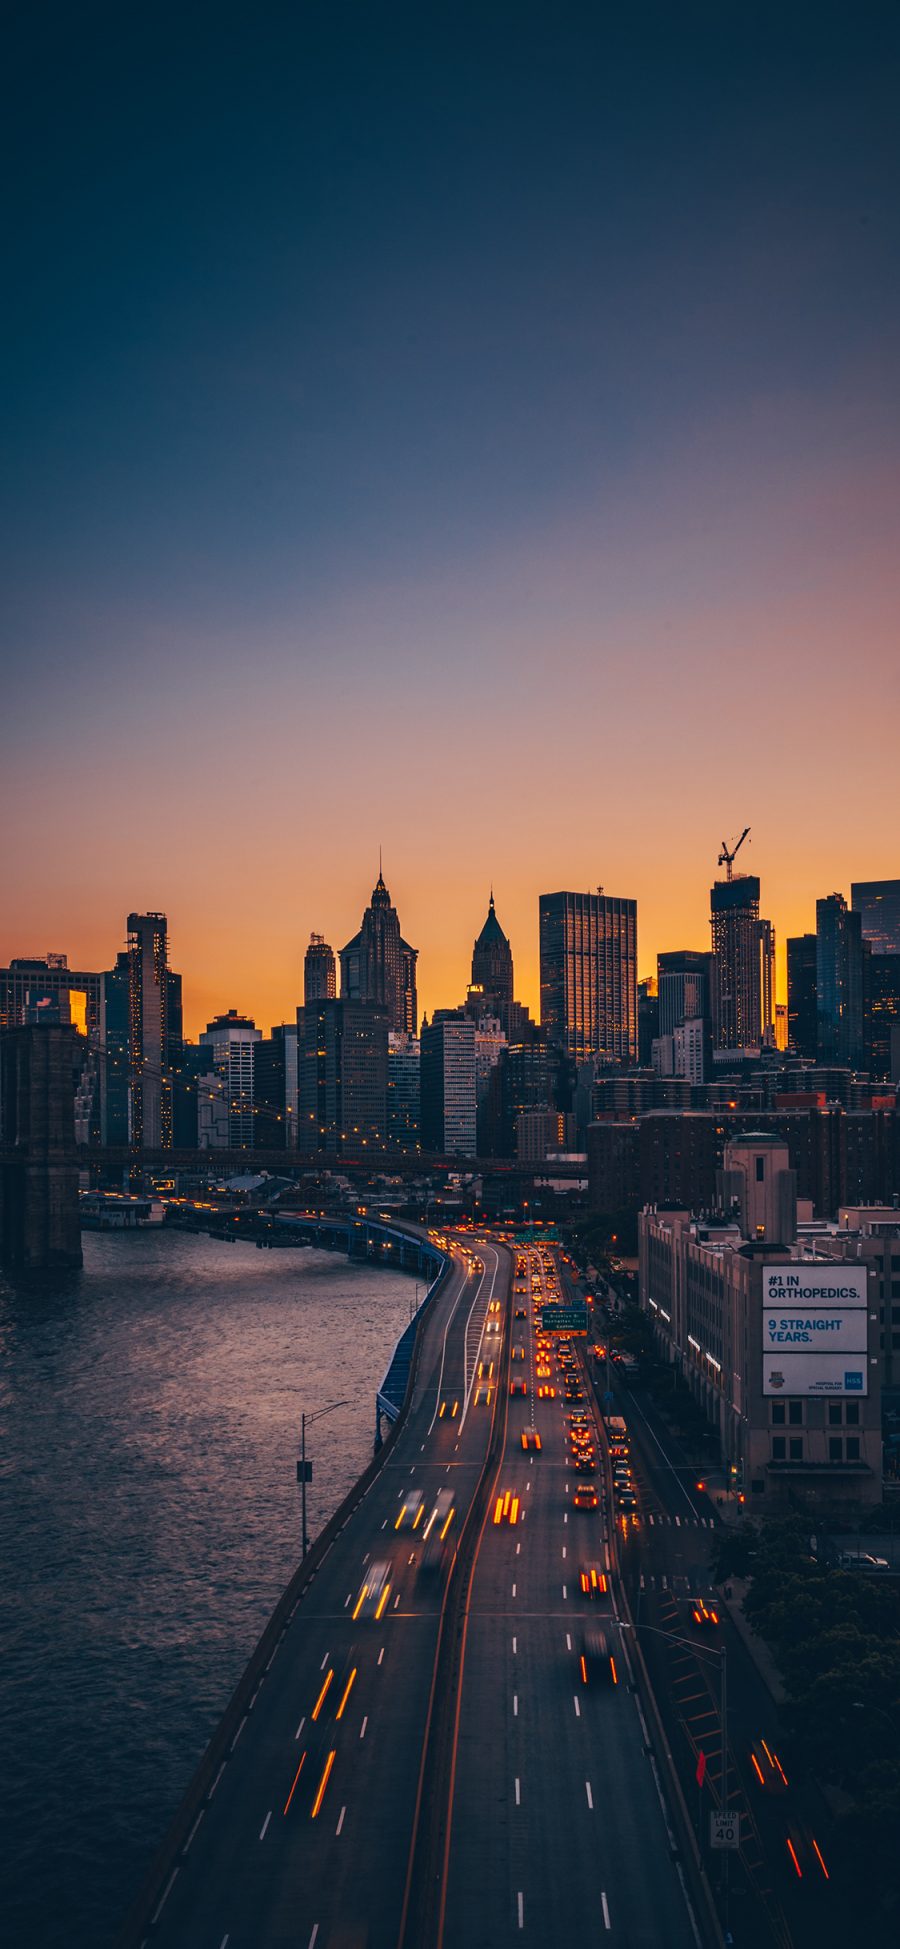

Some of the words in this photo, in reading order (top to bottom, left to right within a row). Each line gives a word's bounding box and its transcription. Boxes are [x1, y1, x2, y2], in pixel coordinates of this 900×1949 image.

[768, 1276, 783, 1286] #1
[786, 1276, 799, 1286] IN
[768, 1288, 860, 1298] ORTHOPEDICS.
[768, 1320, 776, 1330] 9
[780, 1320, 842, 1330] STRAIGHT
[768, 1332, 812, 1342] YEARS.
[847, 1377, 862, 1385] HSS
[716, 1828, 734, 1840] 40
